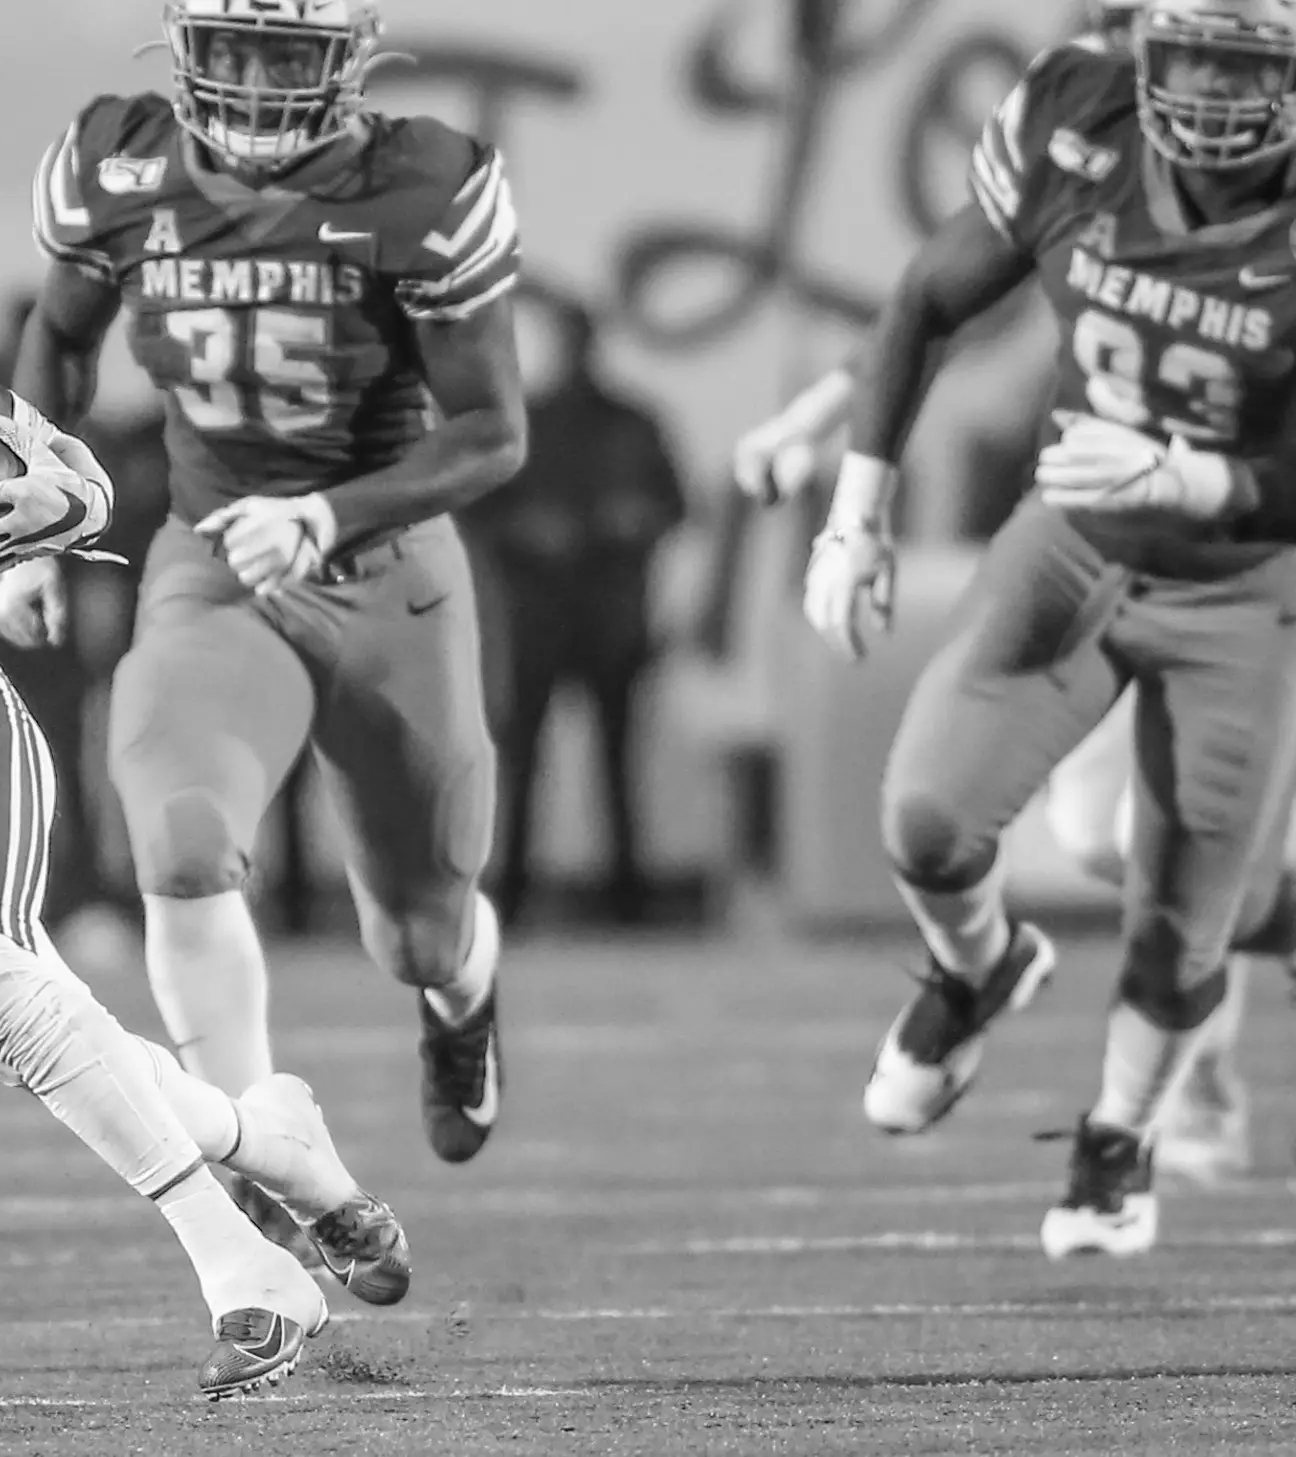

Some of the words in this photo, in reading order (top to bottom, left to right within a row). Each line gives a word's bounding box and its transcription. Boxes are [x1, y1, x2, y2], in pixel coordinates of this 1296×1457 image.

[144, 207, 182, 253] A
[141, 258, 363, 305] MEMPHIS
[1066, 246, 1273, 351] MEMPHIS
[165, 308, 331, 434] 35
